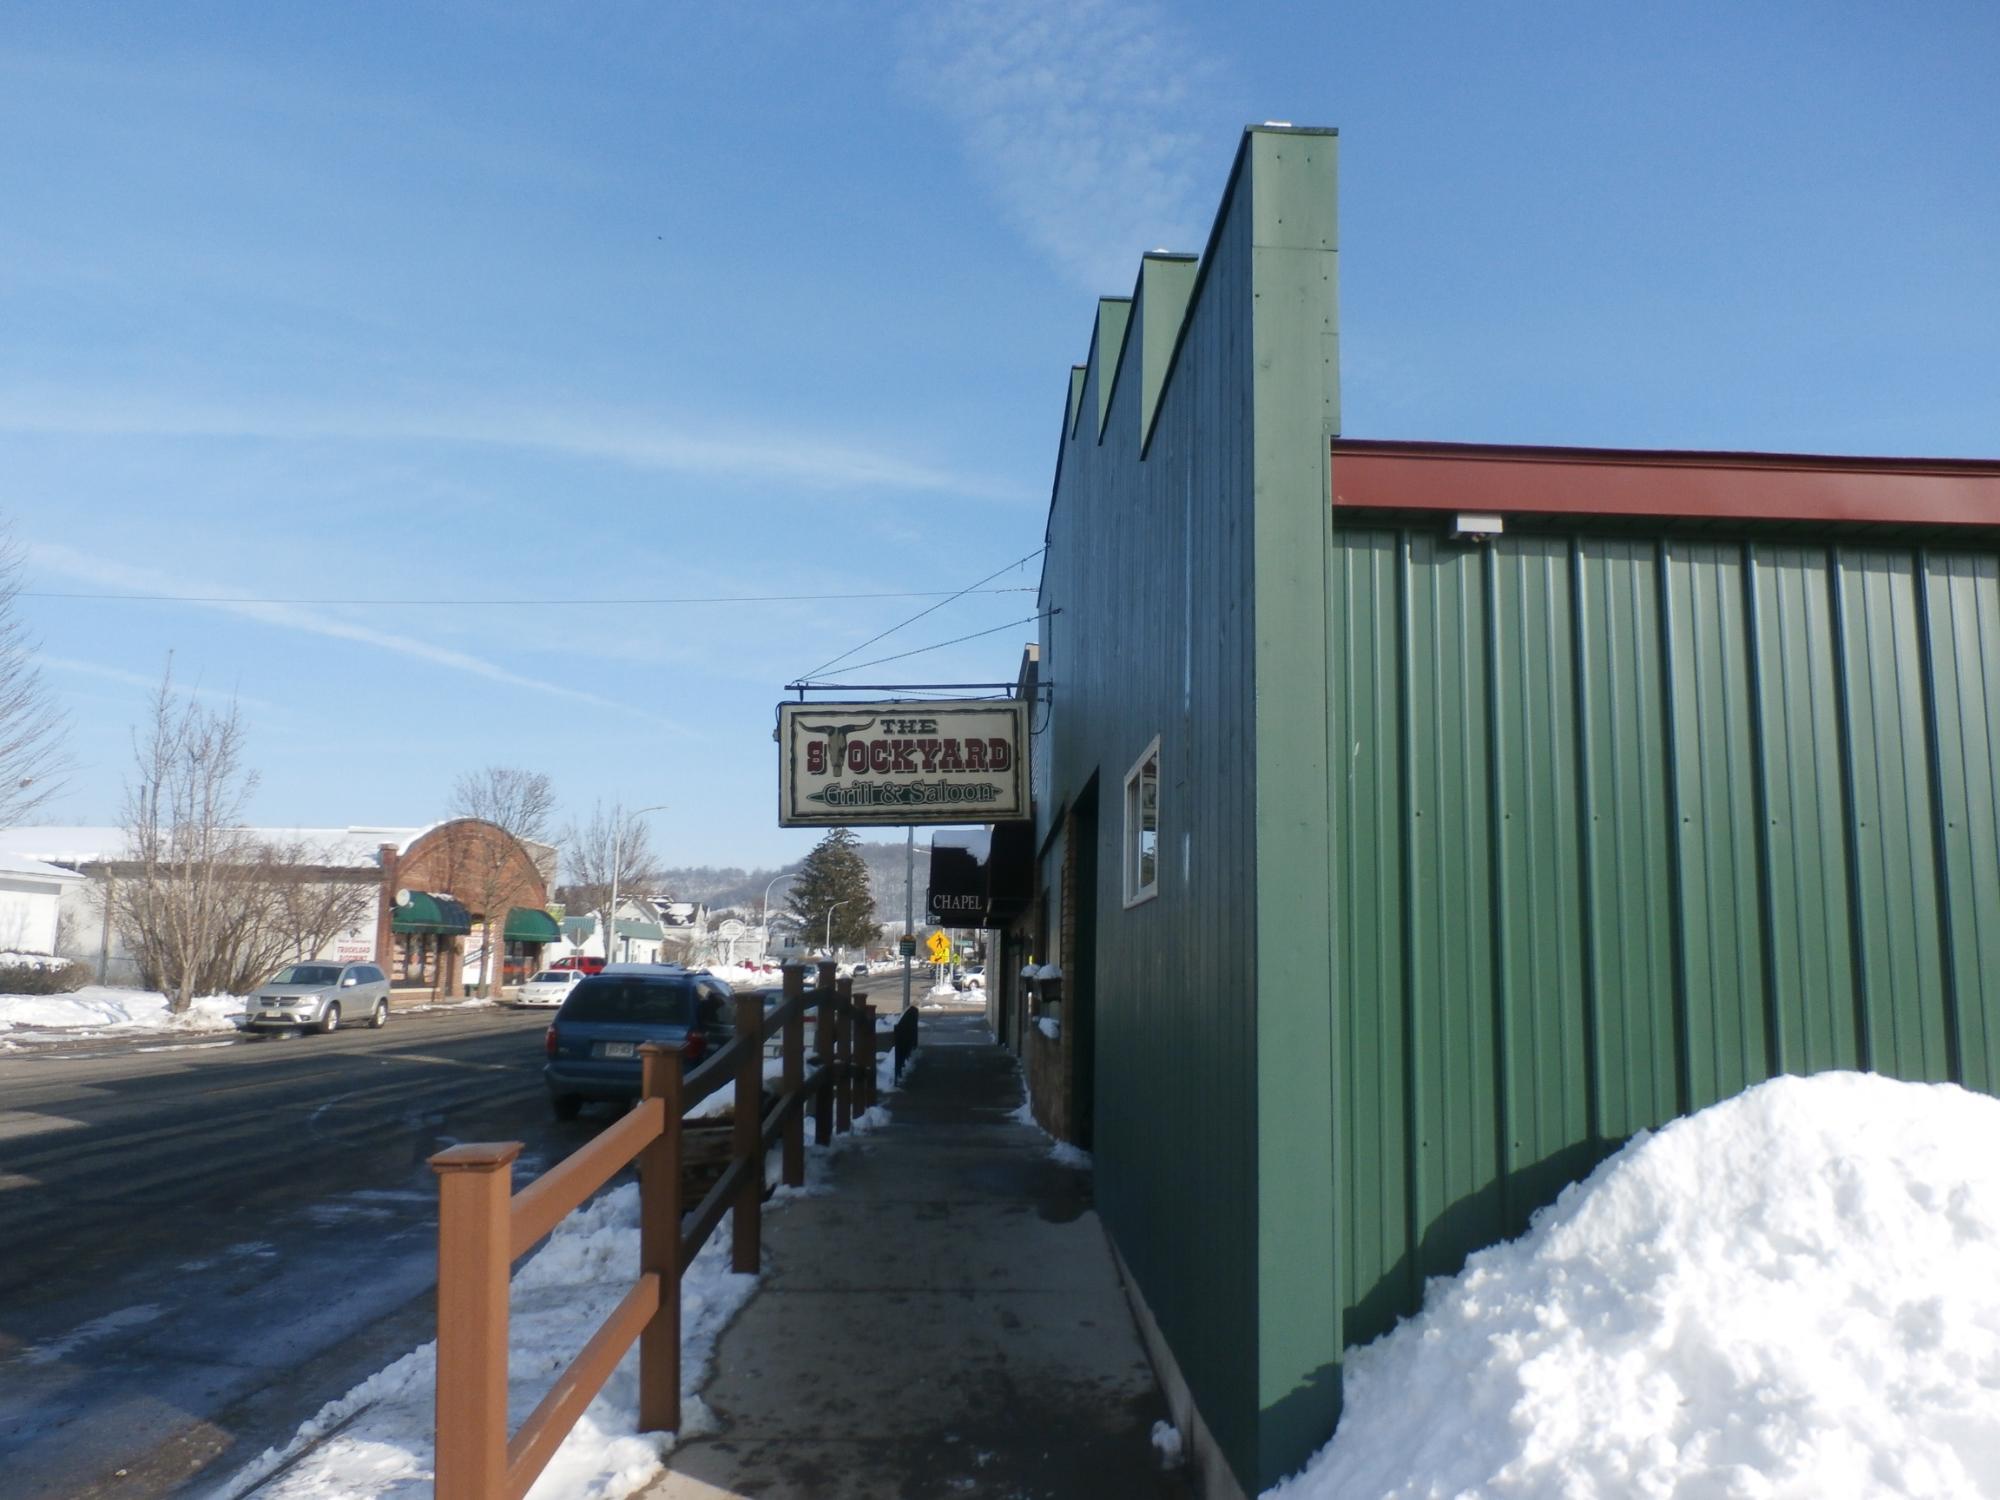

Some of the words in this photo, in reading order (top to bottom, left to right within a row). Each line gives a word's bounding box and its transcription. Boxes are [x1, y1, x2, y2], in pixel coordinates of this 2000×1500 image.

[880, 719, 938, 734] THE
[807, 737, 1012, 776] STOCKYARD
[824, 781, 873, 806] Grill
[881, 782, 901, 804] &
[910, 779, 997, 804] Saloon
[933, 894, 982, 910] CHAPEL
